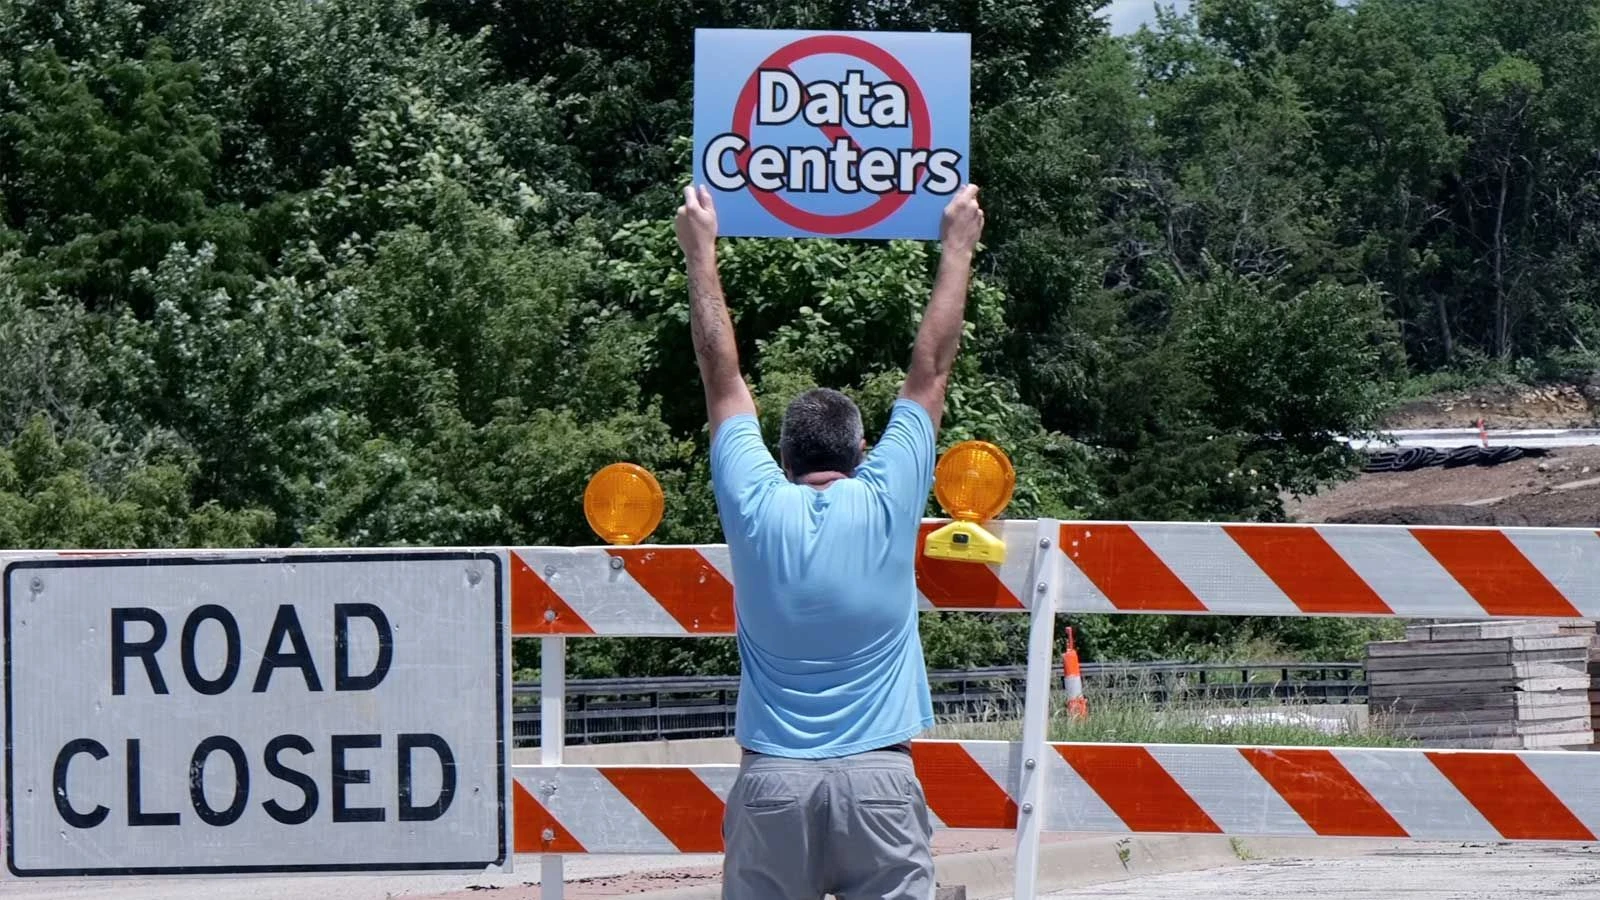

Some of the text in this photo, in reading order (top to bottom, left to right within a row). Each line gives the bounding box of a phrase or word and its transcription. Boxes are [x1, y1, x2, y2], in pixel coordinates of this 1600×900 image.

[757, 68, 909, 128] Data
[703, 133, 962, 196] Centers
[110, 602, 394, 697] ROAD
[52, 732, 457, 830] CLOSED
